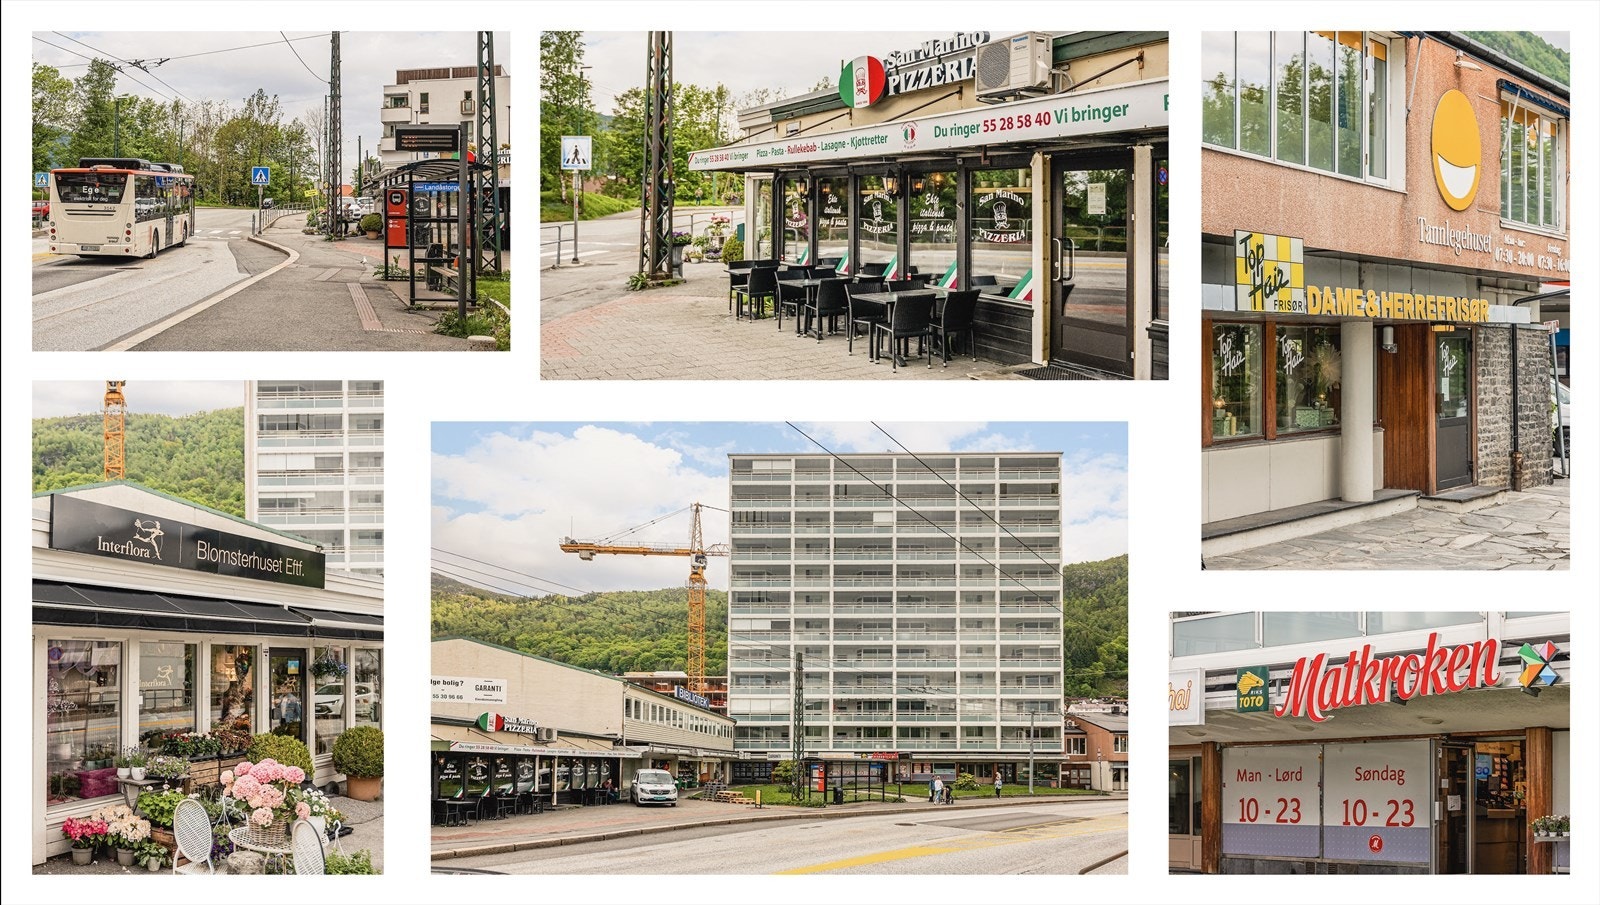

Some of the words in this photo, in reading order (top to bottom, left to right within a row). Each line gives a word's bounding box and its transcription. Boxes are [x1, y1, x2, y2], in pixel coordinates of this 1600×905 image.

[887, 51, 916, 68] San
[920, 31, 984, 59] Marino
[888, 56, 977, 95] PIZZERIA
[934, 125, 948, 138] Du
[950, 123, 980, 138] ringer
[983, 119, 997, 132] 55
[999, 117, 1014, 131] 28
[1017, 114, 1032, 129] 58
[1035, 111, 1051, 126] 40
[1054, 108, 1068, 124] Vi
[1072, 103, 1129, 123] bringer
[756, 149, 768, 157] Pizza
[771, 147, 784, 156] Pasta
[787, 142, 817, 154] Rullekebab
[821, 141, 846, 152] Lasagne
[850, 134, 888, 149] Kjøttretter
[979, 192, 994, 206] San
[995, 189, 1025, 206] Marino
[863, 221, 894, 234] PIZZERIA
[912, 223, 928, 234] pizza
[979, 227, 1026, 243] PIZZERIA
[1417, 216, 1492, 256] Tannlegehuset
[1239, 233, 1264, 278] Top
[1248, 265, 1290, 310] Hair
[1273, 299, 1303, 311] FRISØR
[1217, 333, 1231, 358] Top
[97, 535, 150, 558] Interflora
[197, 540, 282, 573] Blomsterhuset
[285, 557, 305, 577] Eftf.
[1274, 632, 1501, 723] Matkroken
[679, 687, 709, 708] BIBLIOTEK
[1239, 695, 1264, 708] TOTO
[503, 723, 538, 734] PIZZERIA
[1236, 769, 1262, 782] Man
[1275, 766, 1303, 782] Lørd
[1355, 765, 1406, 786] Søndag
[1239, 797, 1259, 823] 10
[1276, 797, 1302, 824] 23
[1342, 799, 1368, 827] 10
[1385, 799, 1416, 828] 23
